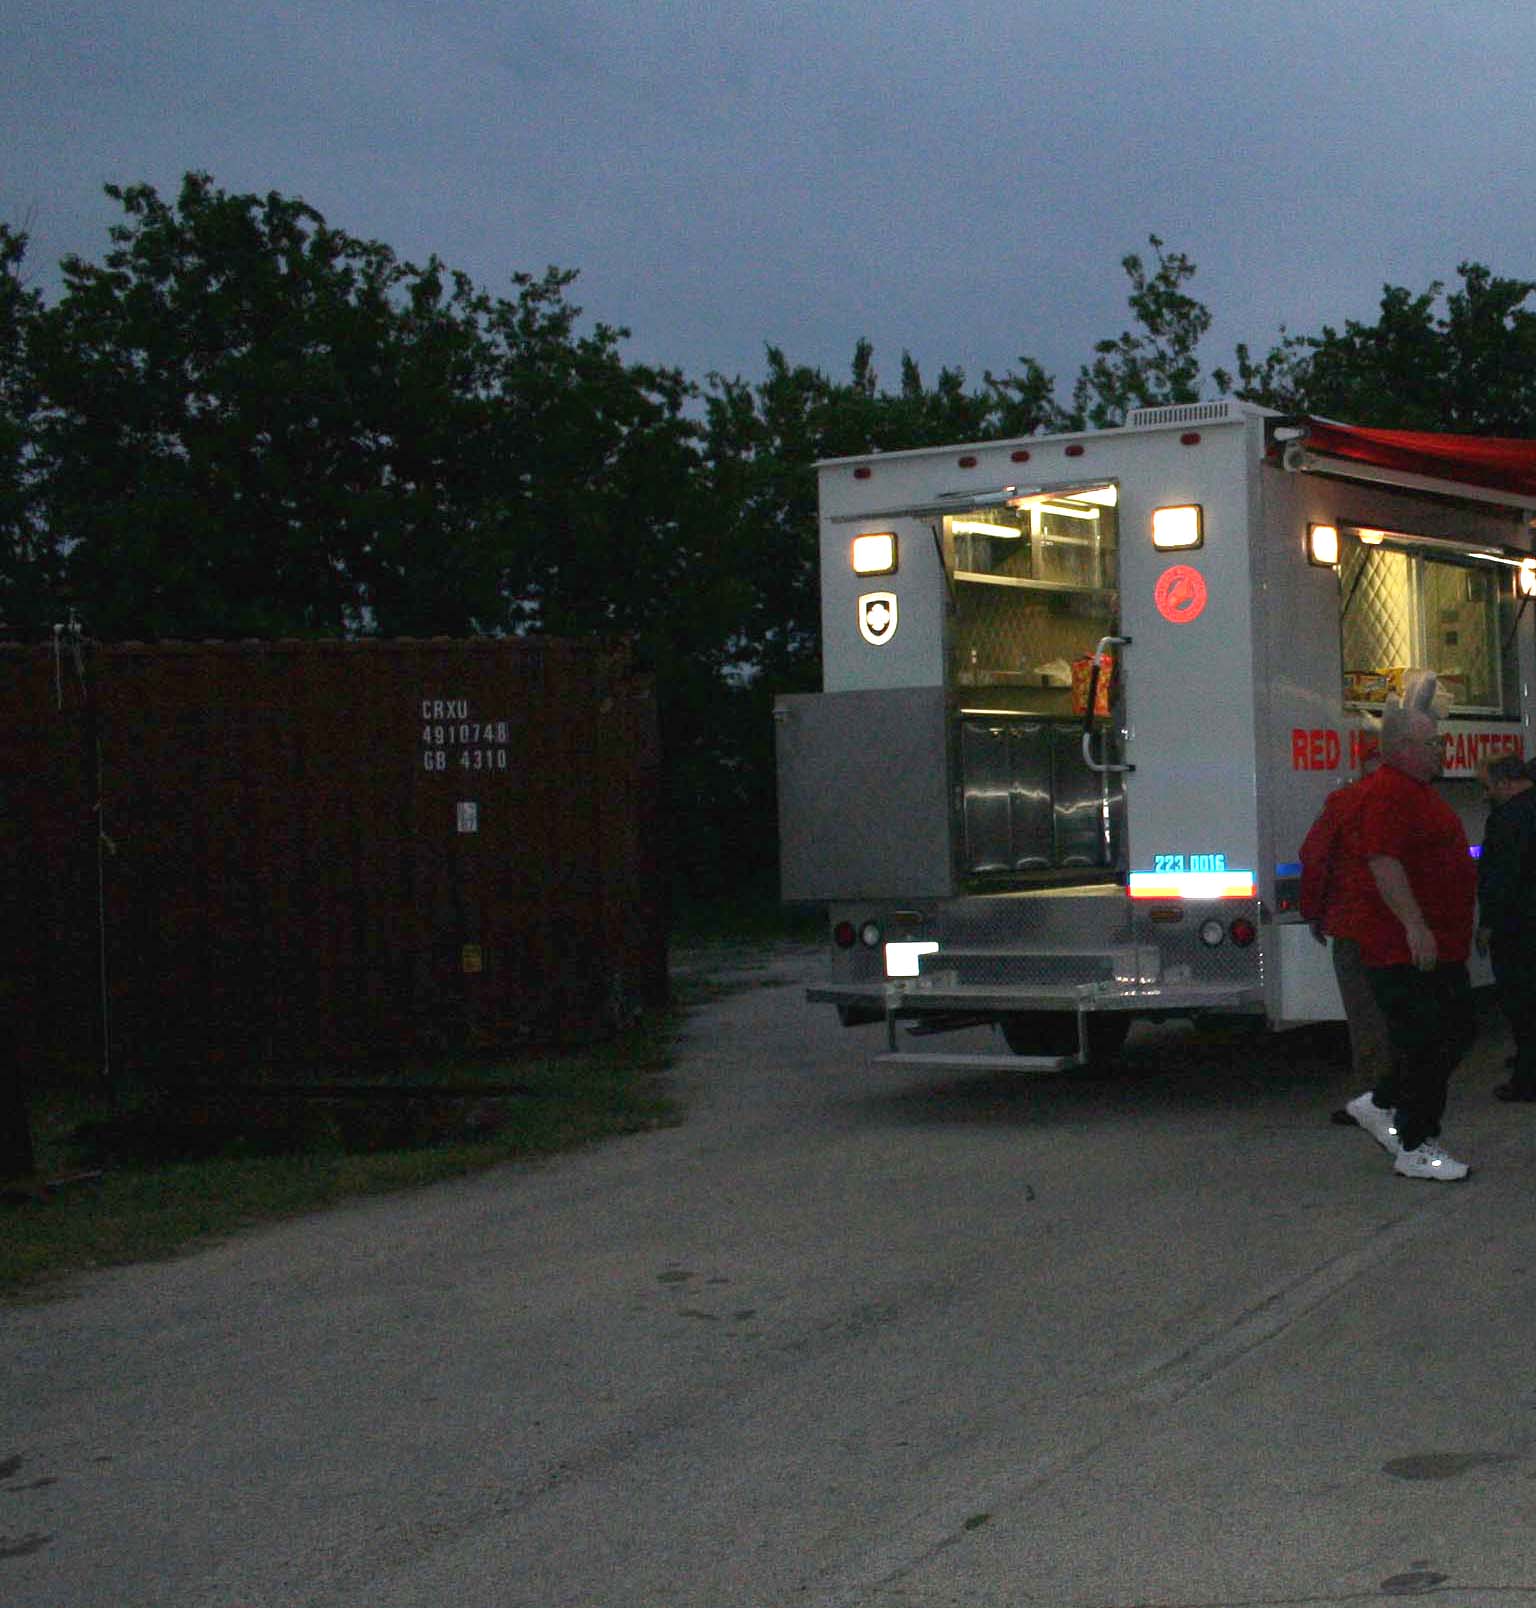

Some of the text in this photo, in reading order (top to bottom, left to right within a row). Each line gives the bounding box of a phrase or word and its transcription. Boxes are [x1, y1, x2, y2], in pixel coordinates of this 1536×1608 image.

[421, 700, 468, 719] CRXU
[422, 722, 512, 744] 4910748
[423, 748, 508, 772] GB 4310
[1292, 728, 1341, 771] RED
[1154, 853, 1225, 873] 223 0016
